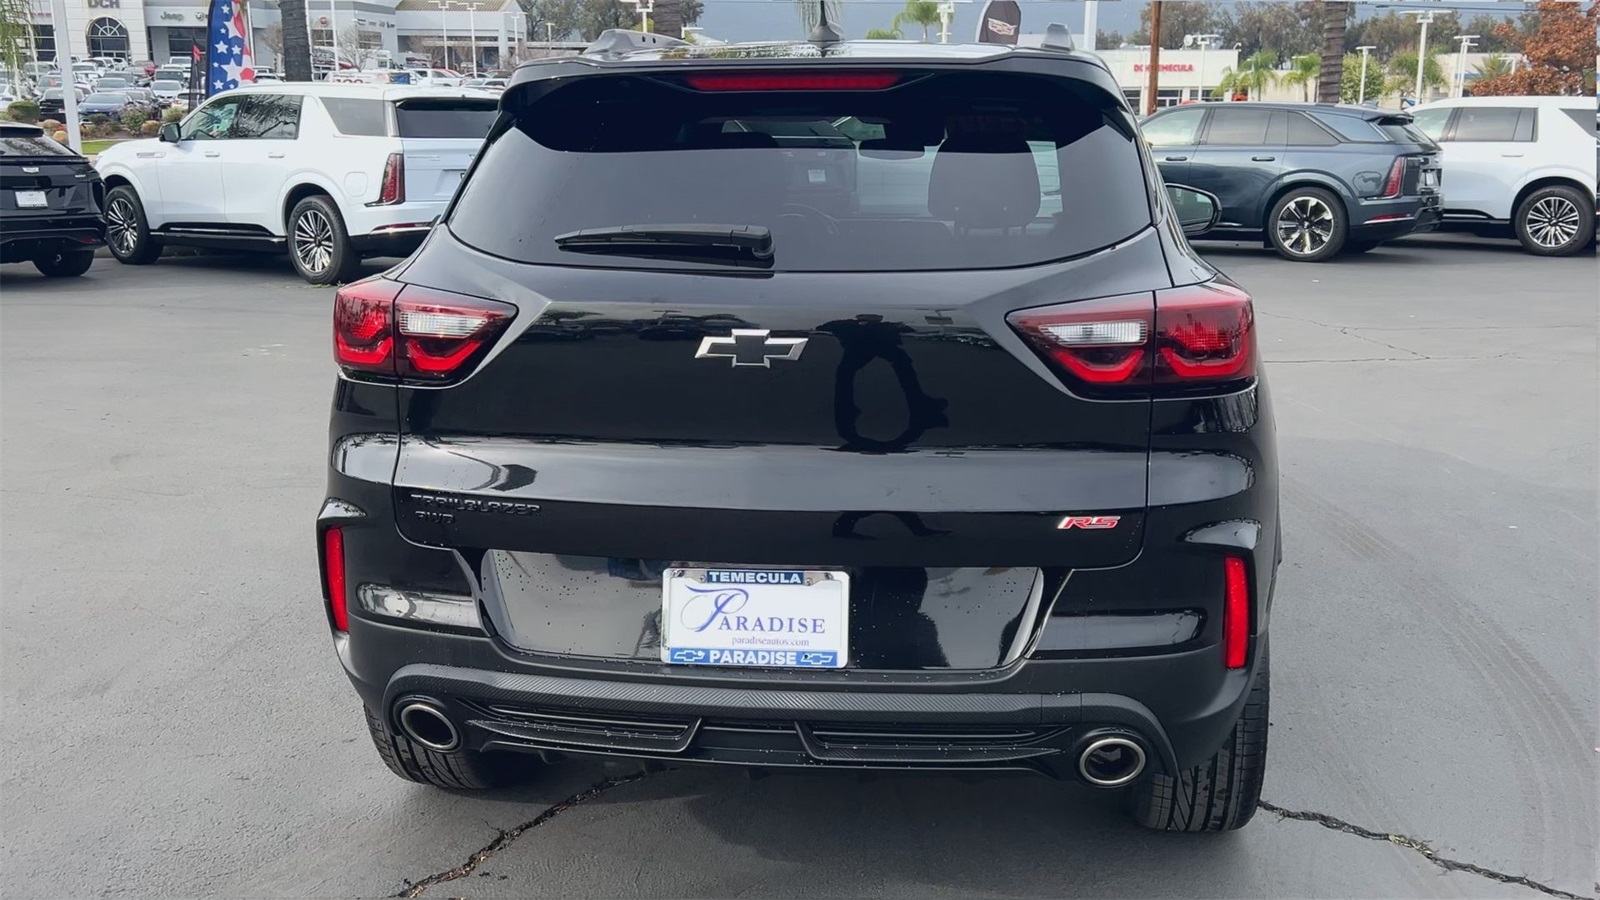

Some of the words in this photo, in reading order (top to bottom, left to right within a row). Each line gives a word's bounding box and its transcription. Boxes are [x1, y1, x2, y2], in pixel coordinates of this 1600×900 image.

[160, 12, 184, 20] Jeep
[1152, 64, 1193, 72] EMECULA
[410, 493, 541, 516] TRAILBLAZER
[1057, 515, 1121, 530] RS
[708, 571, 802, 584] TEMECULA
[680, 584, 826, 634] PARADISE
[731, 636, 810, 647] paradiseautos.com
[708, 650, 797, 665] PARADISE
